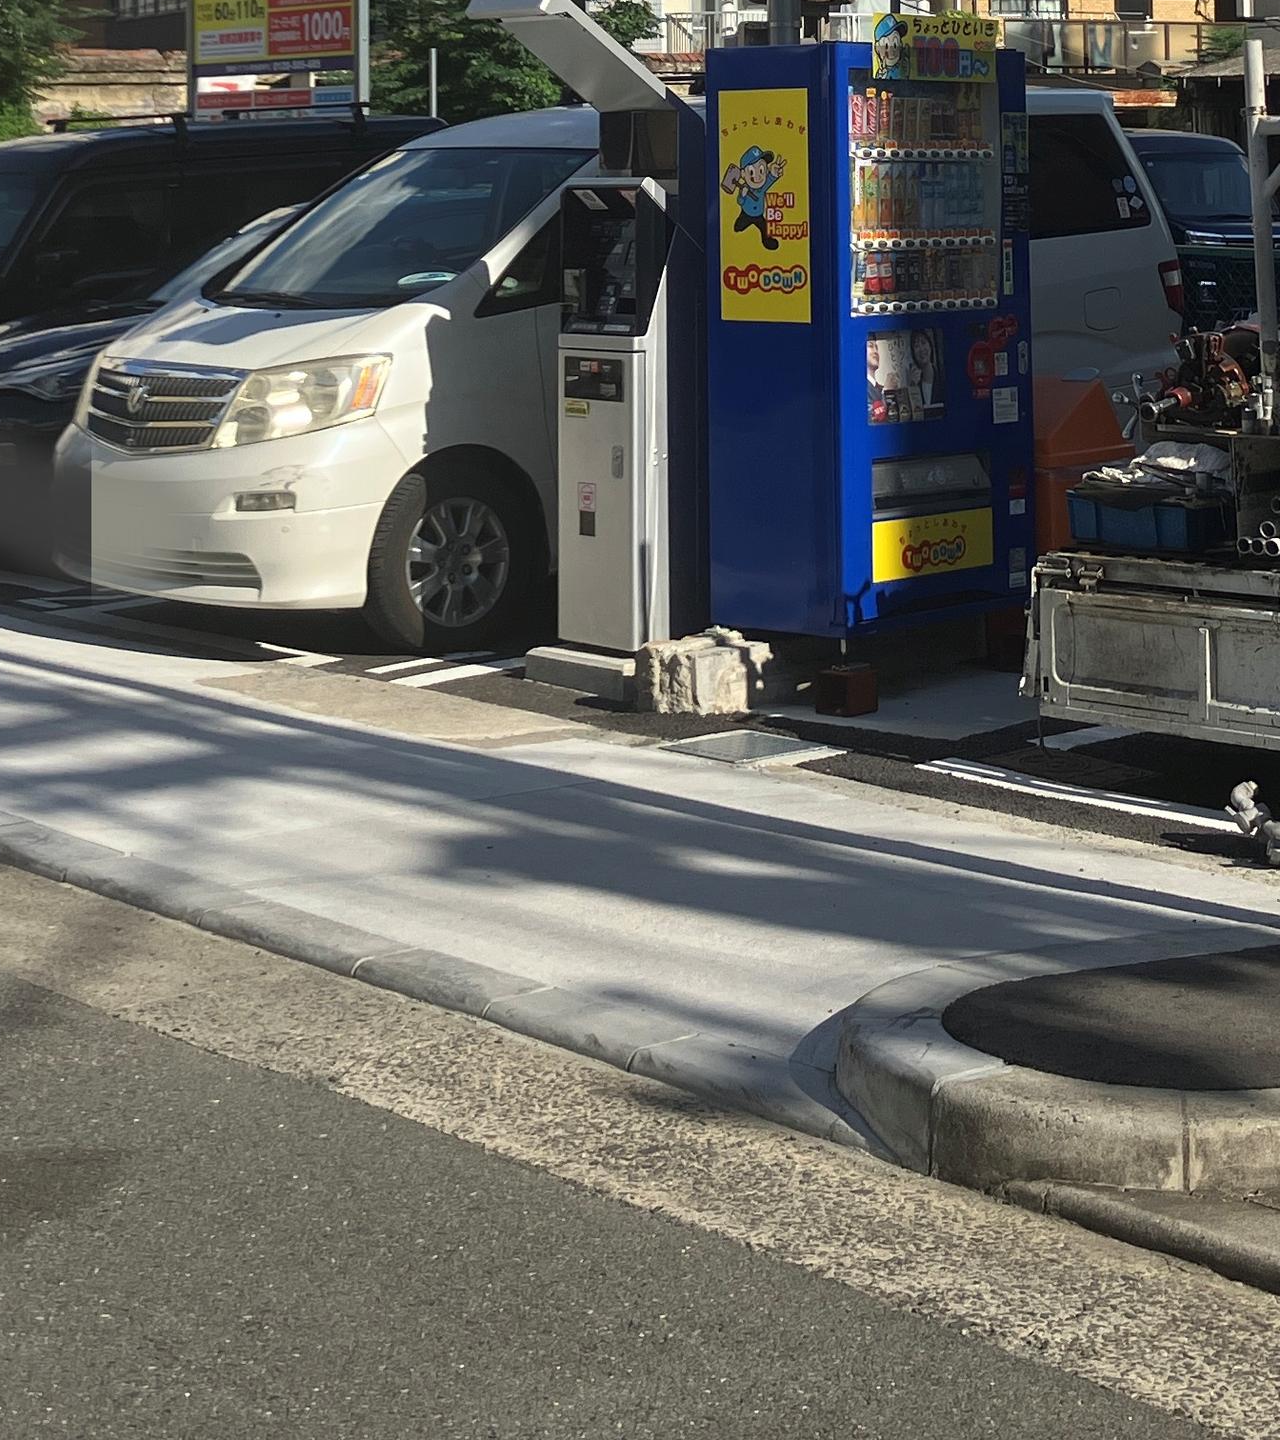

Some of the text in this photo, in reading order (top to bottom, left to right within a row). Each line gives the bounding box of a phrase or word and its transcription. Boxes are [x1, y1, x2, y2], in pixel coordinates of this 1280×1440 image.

[912, 18, 995, 37] ちょっとひといき
[721, 116, 806, 136] ちょっとしあわせ
[766, 193, 794, 208] We'll
[766, 208, 782, 221] Be
[766, 222, 808, 239] Happy!
[728, 270, 802, 290] TWO DOWN
